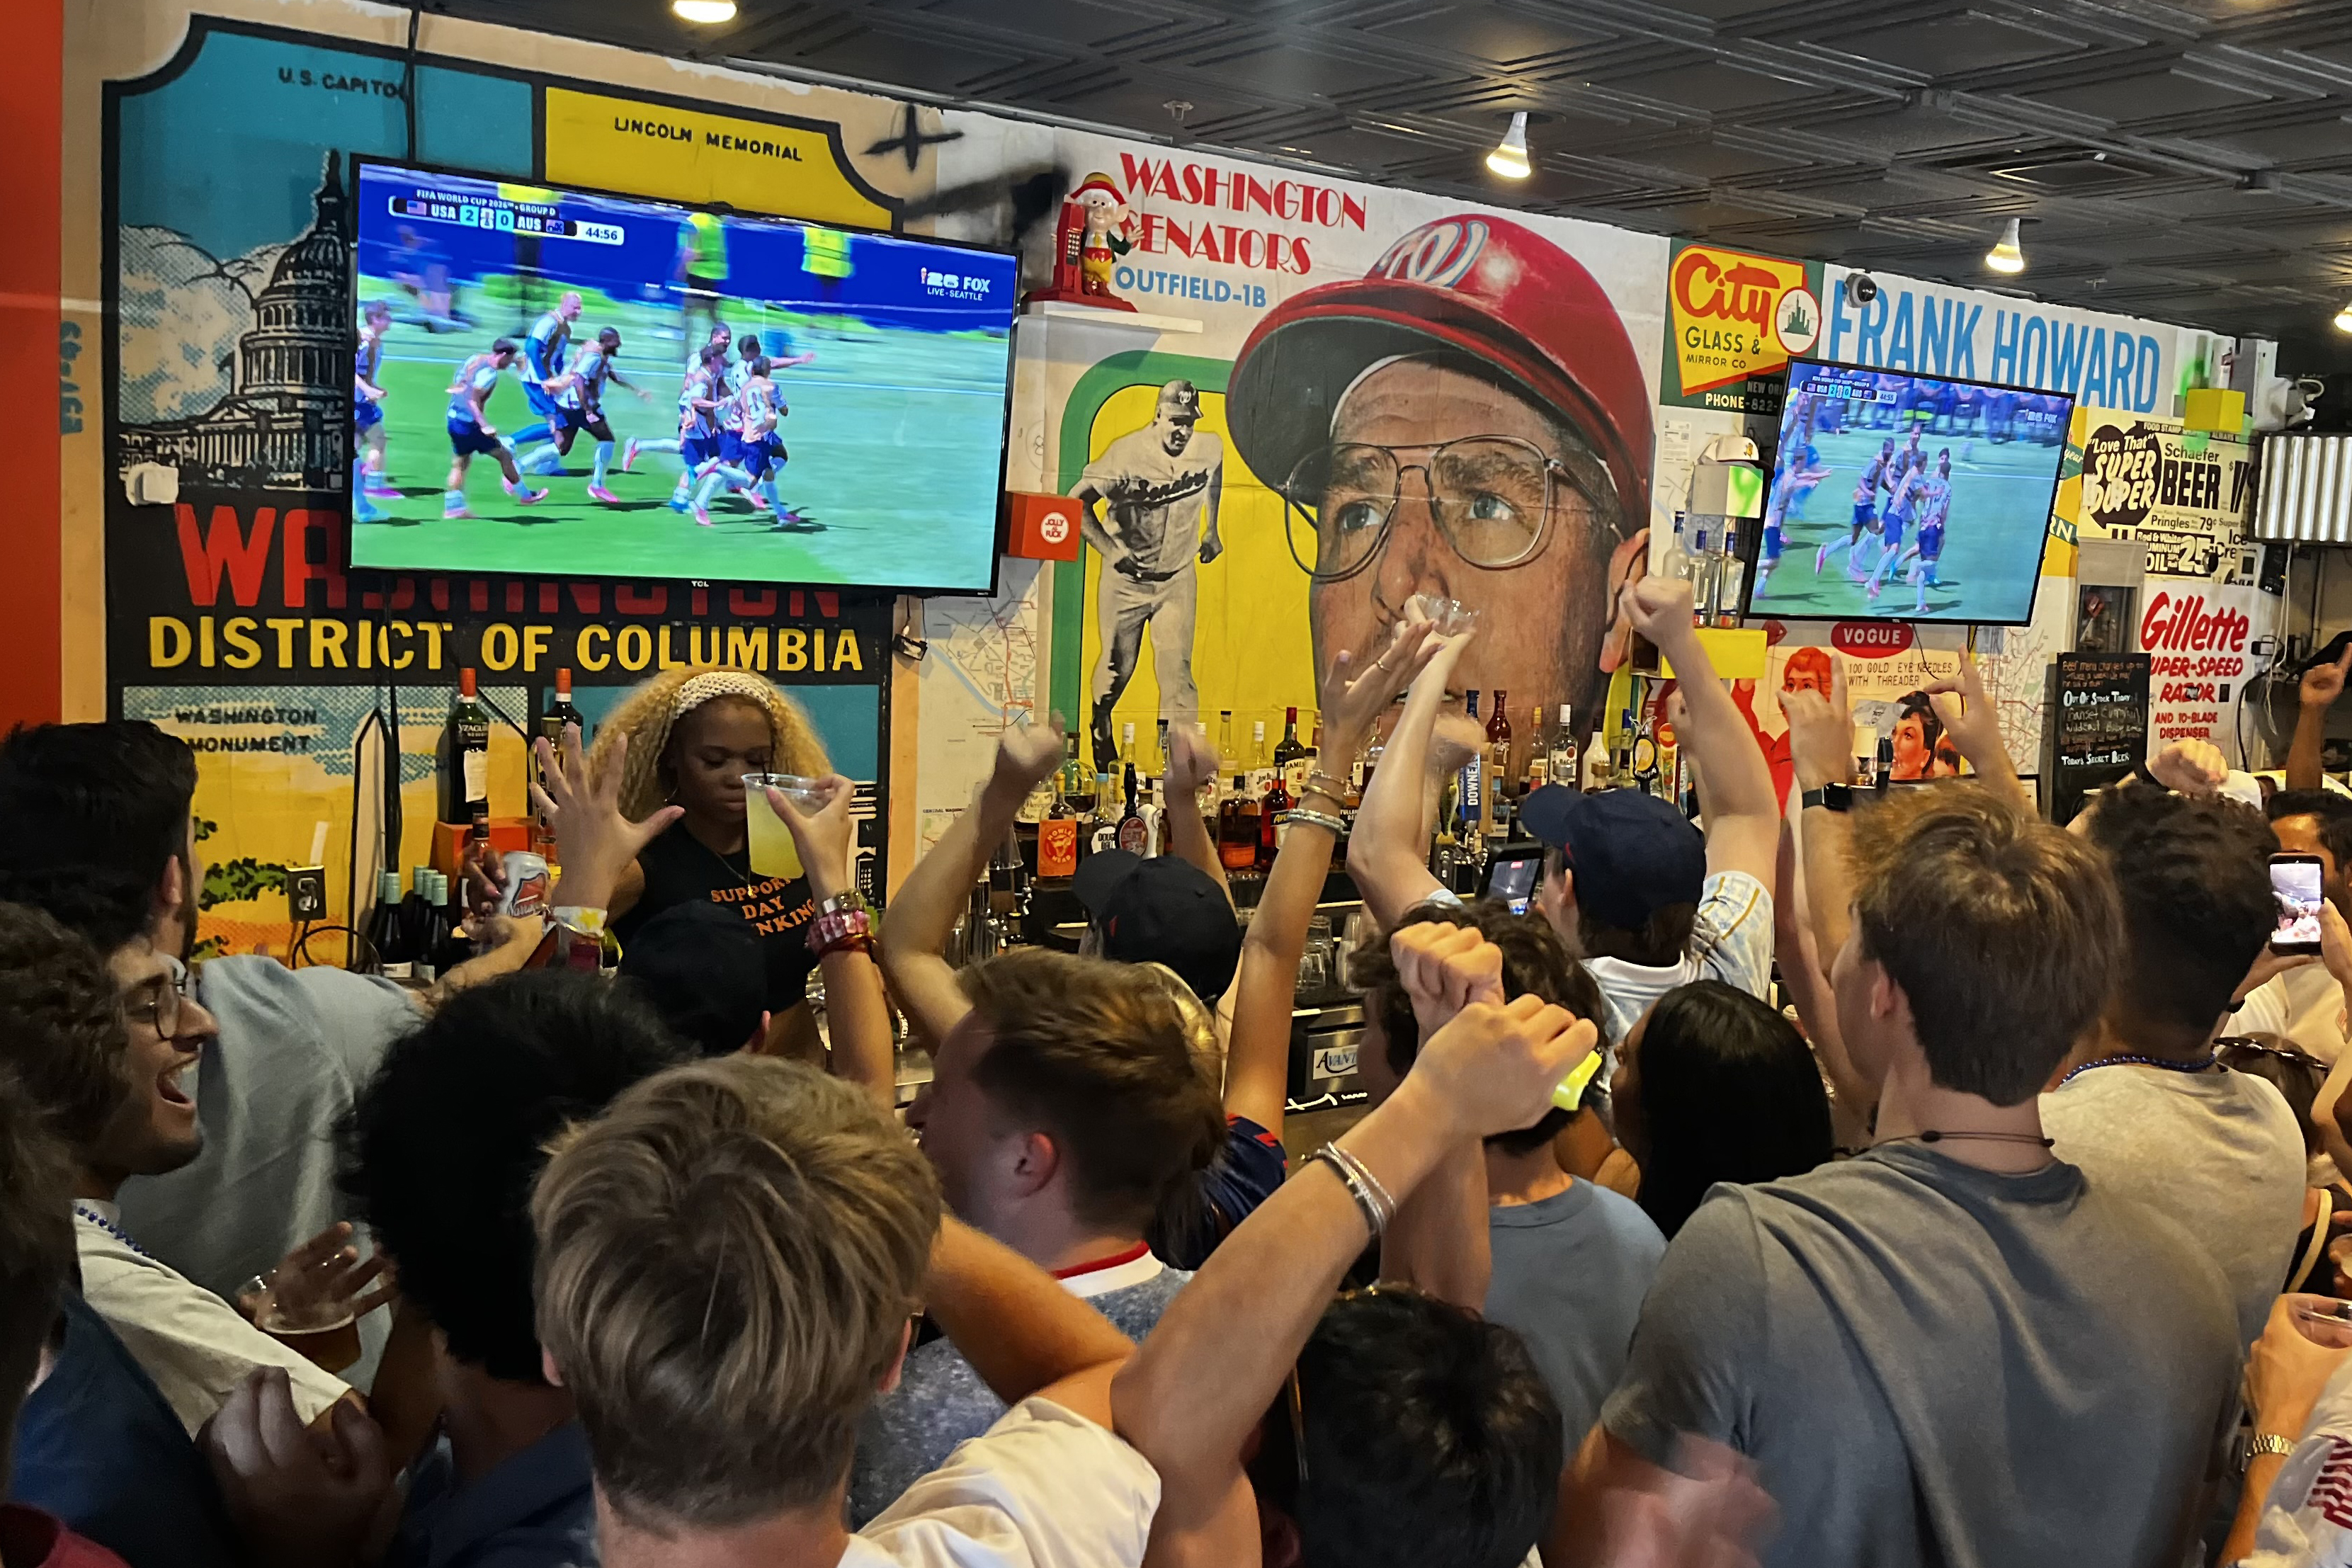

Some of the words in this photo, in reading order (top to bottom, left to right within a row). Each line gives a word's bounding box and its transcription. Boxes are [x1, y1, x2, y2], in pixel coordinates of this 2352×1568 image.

[323, 74, 409, 102] CAPITO
[614, 117, 692, 142] LINCOLN
[706, 132, 803, 162] MEMORIAL
[416, 189, 436, 200] FIFA
[437, 192, 469, 204] WORLD
[470, 196, 487, 206] CUP
[519, 204, 548, 215] GROUP
[550, 208, 556, 216] D
[1120, 152, 1367, 232] WASHINGTON
[431, 205, 456, 220] USA
[465, 210, 474, 222] 2
[500, 215, 509, 226] 0
[517, 215, 542, 231] AUS
[585, 227, 618, 241] 44:56
[927, 287, 945, 297] LIVE
[949, 290, 983, 301] SEATTLE
[963, 276, 991, 292] FOX
[1115, 266, 1266, 307] OUTFIELD-1B
[1675, 253, 1780, 339] City
[1686, 326, 1744, 353] GLASS
[1751, 334, 1761, 356] &
[1829, 279, 1983, 380] FRANK
[1991, 309, 2161, 414] HOWARD
[1686, 354, 1727, 367] MIRROR
[1732, 359, 1746, 369] CO
[1747, 380, 1766, 394] NEW
[2143, 421, 2161, 432] FOOD
[2161, 424, 2181, 434] STAMP
[2164, 443, 2220, 462] Schaefer
[2095, 450, 2157, 483] SUPER
[2160, 459, 2221, 510] BEER
[2049, 515, 2074, 542] RN
[2151, 515, 2190, 530] Pringles
[2137, 531, 2152, 542] Red
[2229, 528, 2248, 546] Ice
[2147, 542, 2181, 554] UMINUM
[2145, 553, 2169, 572] OIL
[2140, 591, 2249, 652] Gillette
[149, 615, 453, 669] DISTRICT
[481, 623, 554, 672] OF
[576, 624, 863, 671] COLUMBIA
[1843, 627, 1902, 644] VOGUE
[1849, 663, 1863, 674] 100
[1867, 662, 1890, 674] GOLD
[1897, 662, 1914, 673] EYE
[1916, 662, 1953, 674] NEEDLES
[2150, 656, 2244, 678] UPER-SPEED
[1848, 675, 1869, 687] WITH
[1877, 675, 1919, 686] THREADER
[2160, 682, 2216, 704] RAZOR
[175, 709, 317, 726] WASHINGTON
[2154, 712, 2174, 725] AND
[2178, 712, 2218, 724] 10-BLADE
[187, 735, 310, 752] MONUMENT
[2160, 727, 2210, 739] DISPENSER
[1467, 754, 1479, 806] DOWNEA
[710, 877, 791, 903] SUPPOR
[741, 895, 785, 920] DAY
[752, 898, 814, 937] NKING
[1315, 1051, 1358, 1074] AVANT
